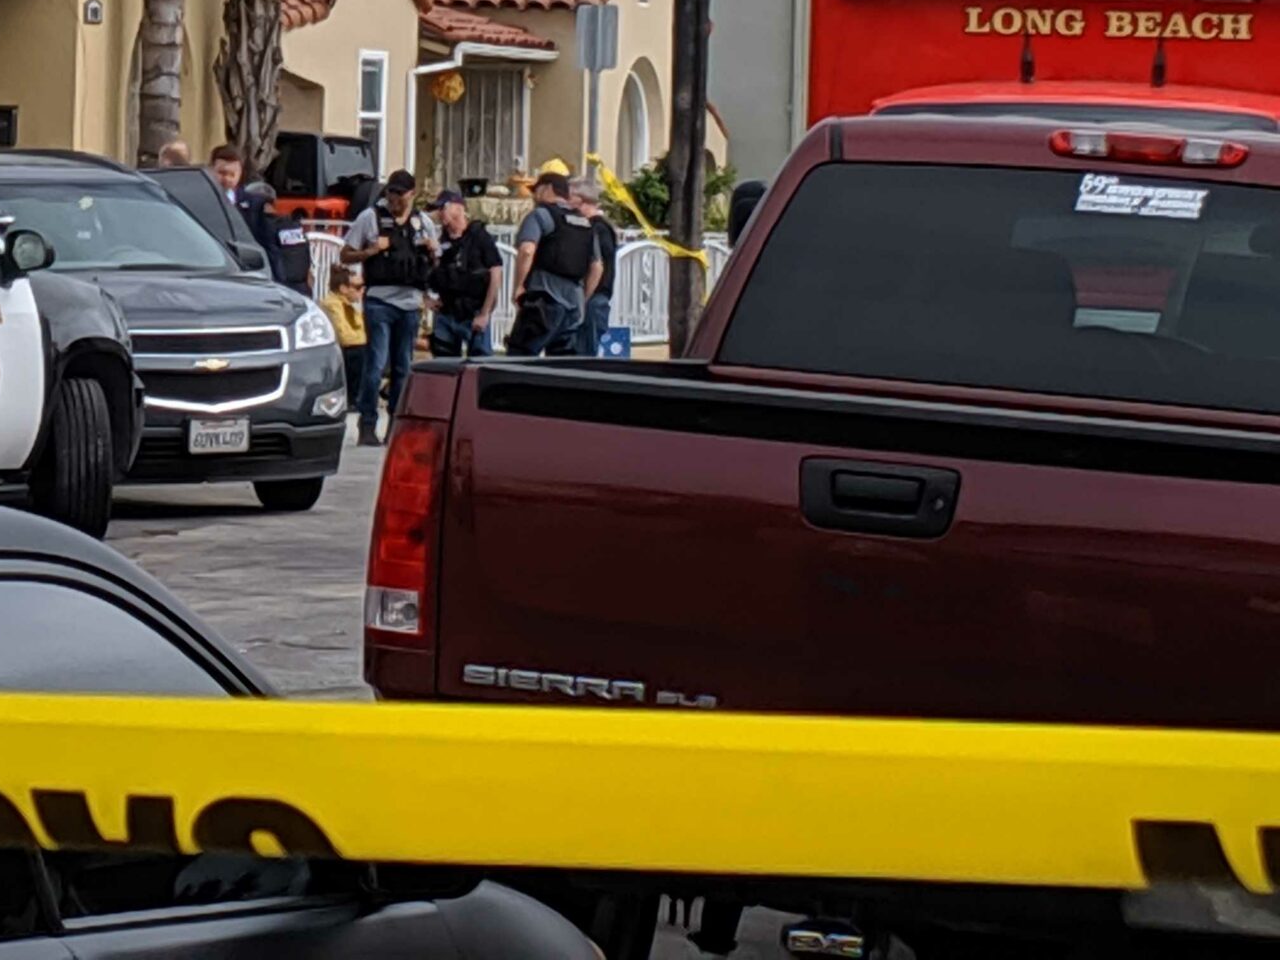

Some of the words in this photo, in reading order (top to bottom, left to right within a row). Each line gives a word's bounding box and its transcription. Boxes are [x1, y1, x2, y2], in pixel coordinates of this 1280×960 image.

[965, 7, 1085, 35] LONG
[1105, 11, 1253, 40] BEACH
[463, 664, 645, 701] SIERRA
